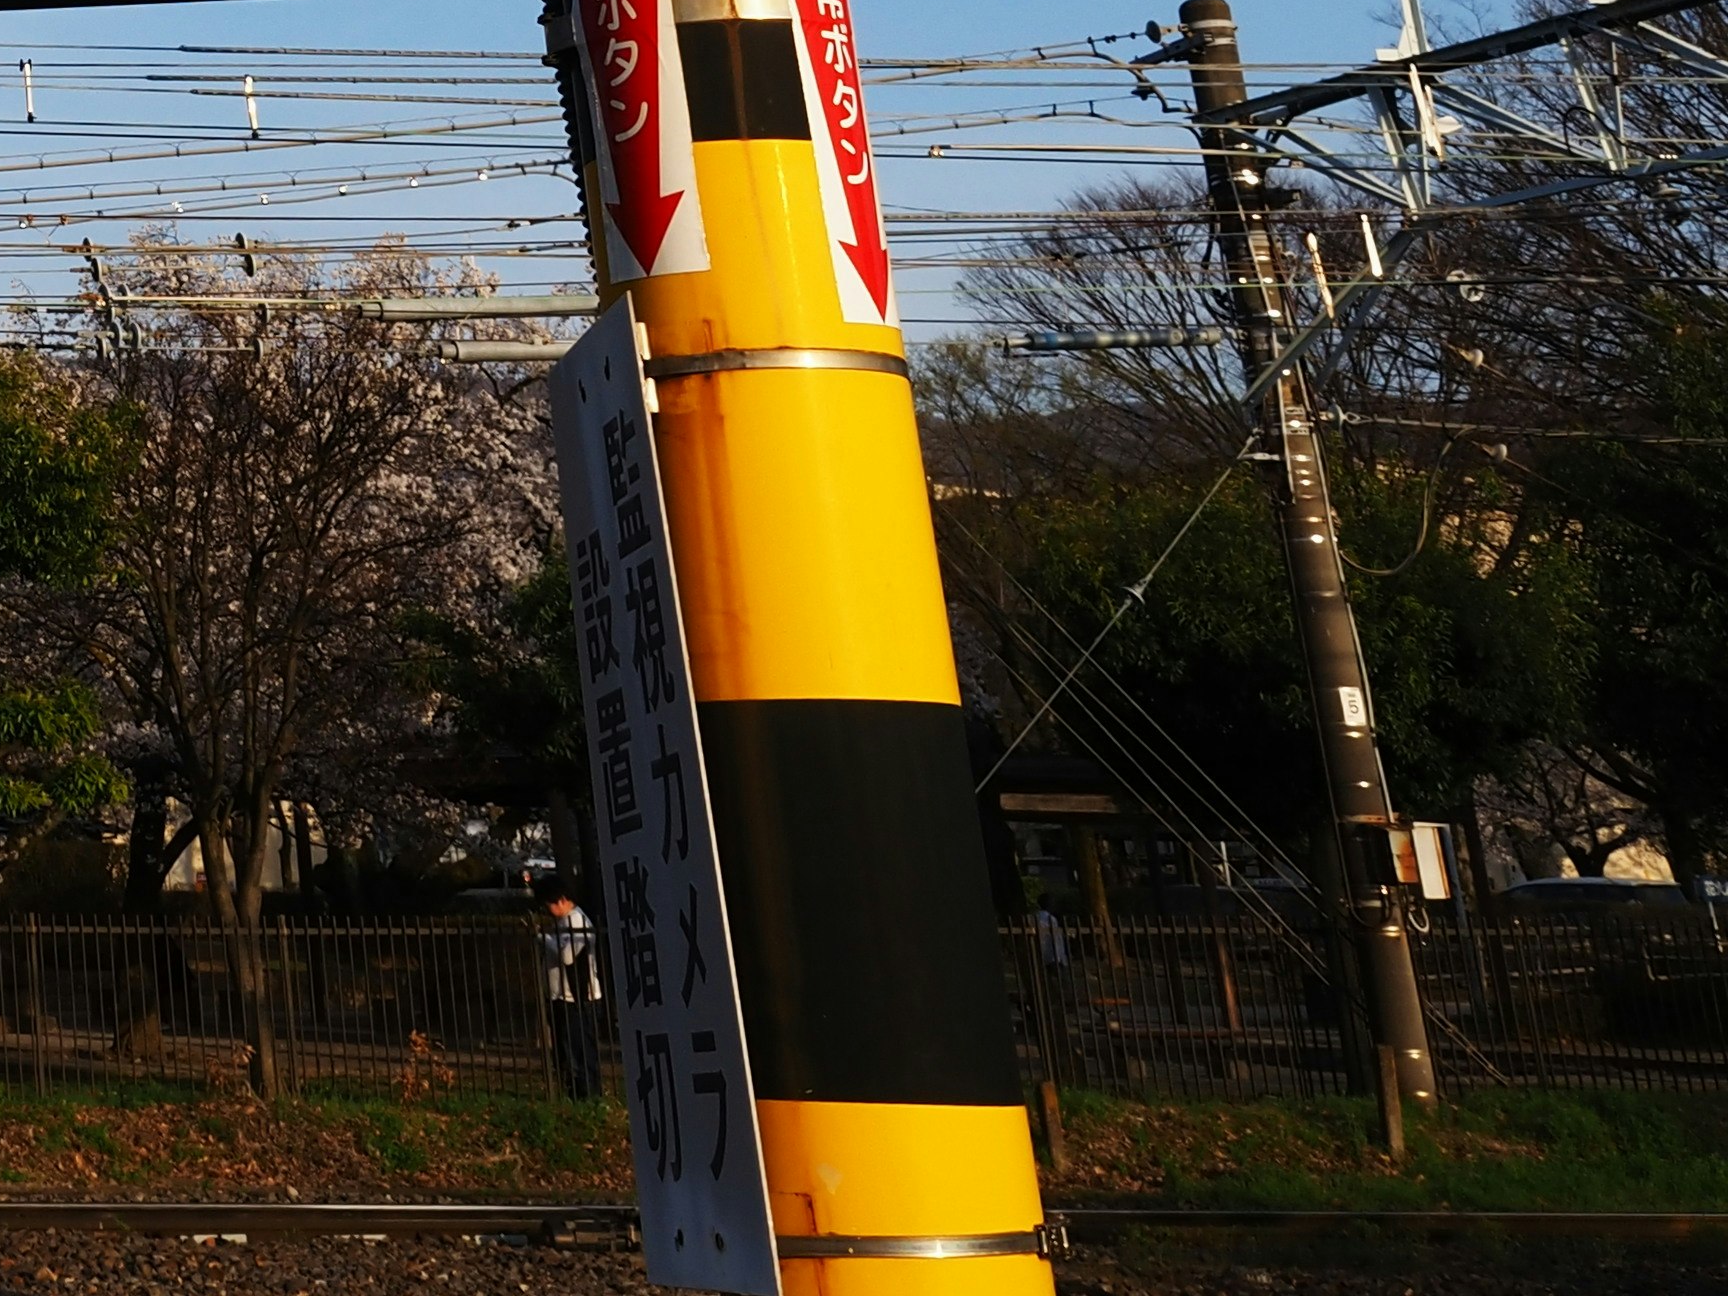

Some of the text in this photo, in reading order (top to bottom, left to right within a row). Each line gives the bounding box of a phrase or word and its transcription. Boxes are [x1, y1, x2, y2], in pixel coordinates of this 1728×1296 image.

[576, 528, 684, 1182] 設置踏切
[602, 408, 728, 1182] 監視カメラ
[1348, 699, 1359, 714] 5
